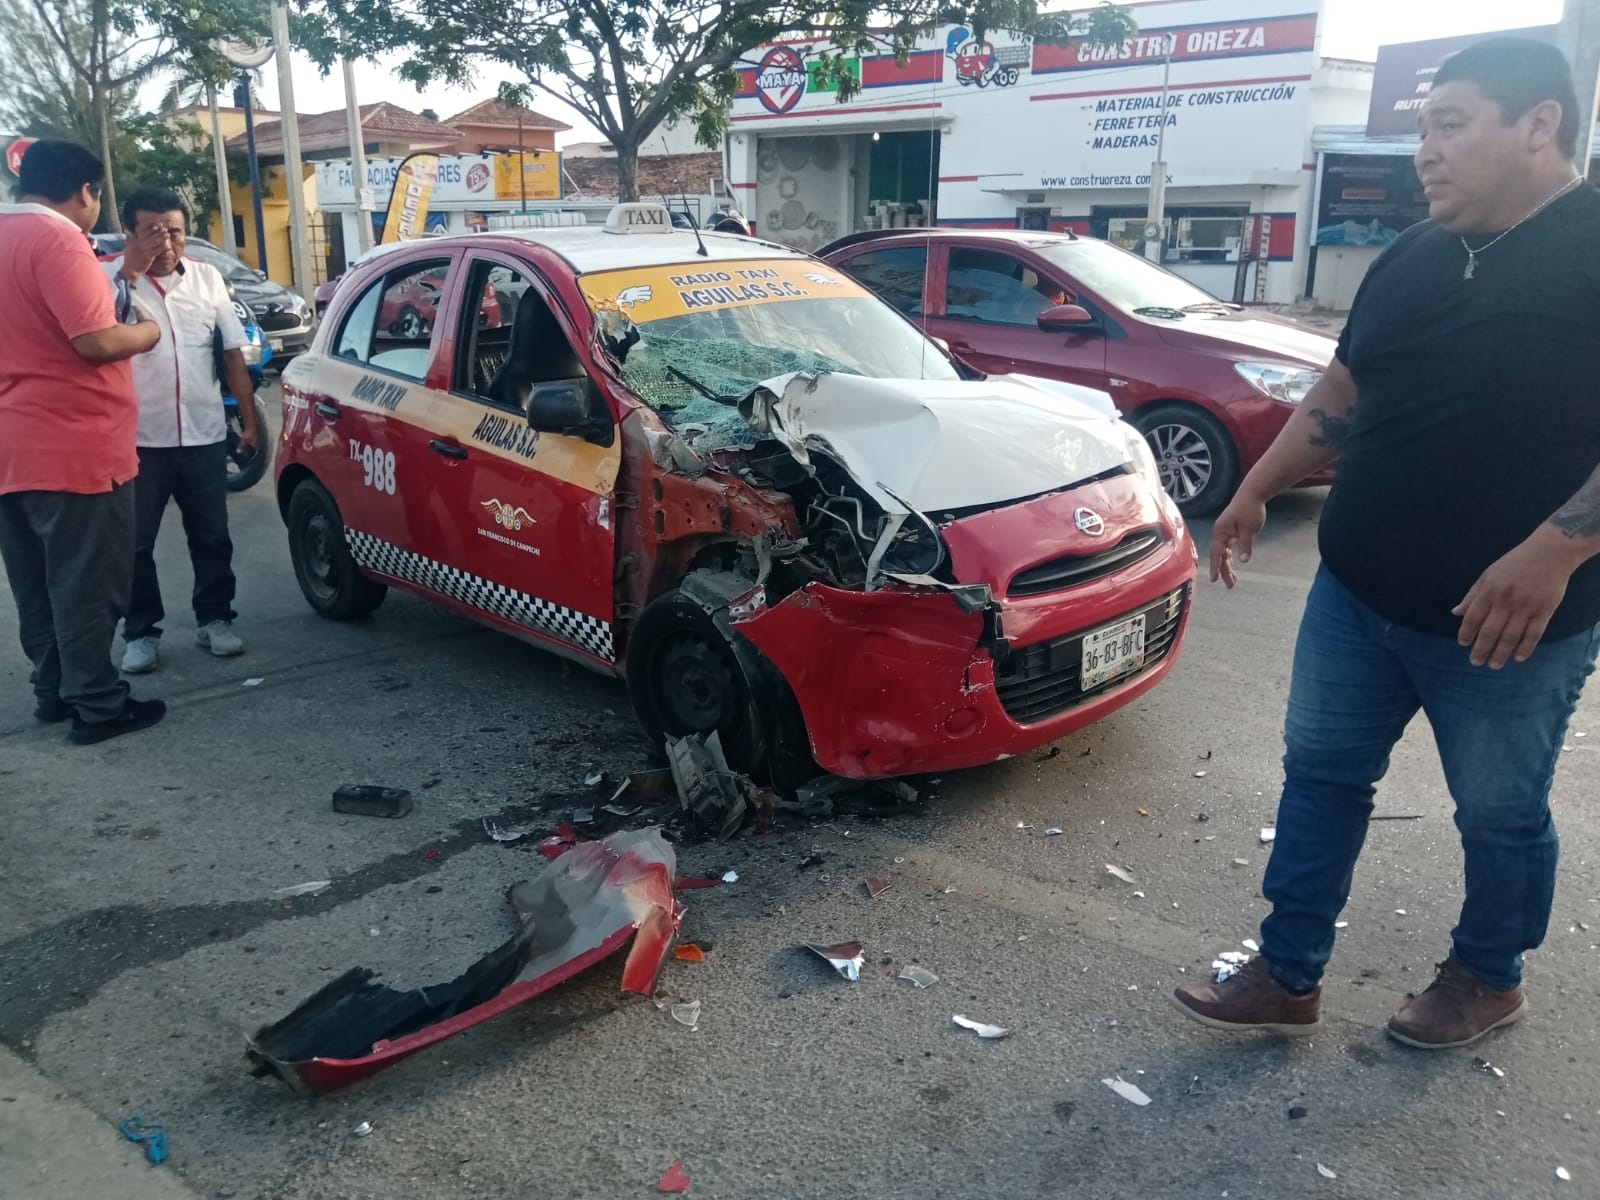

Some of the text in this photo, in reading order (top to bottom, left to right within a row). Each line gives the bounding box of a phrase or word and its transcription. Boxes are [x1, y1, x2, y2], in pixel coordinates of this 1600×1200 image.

[1187, 27, 1265, 53] OREZA
[760, 72, 801, 89] MAYA
[1095, 83, 1296, 113] MATERIAL DE CONSTRUCCIÓN
[1094, 111, 1177, 131] FERRETERÍA
[1092, 134, 1159, 149] MADERAS
[624, 209, 665, 225] TAXI
[670, 268, 780, 286] RADIO TAXI
[679, 281, 809, 308] AGUILAS S.C.
[472, 412, 522, 451] AGUILAS
